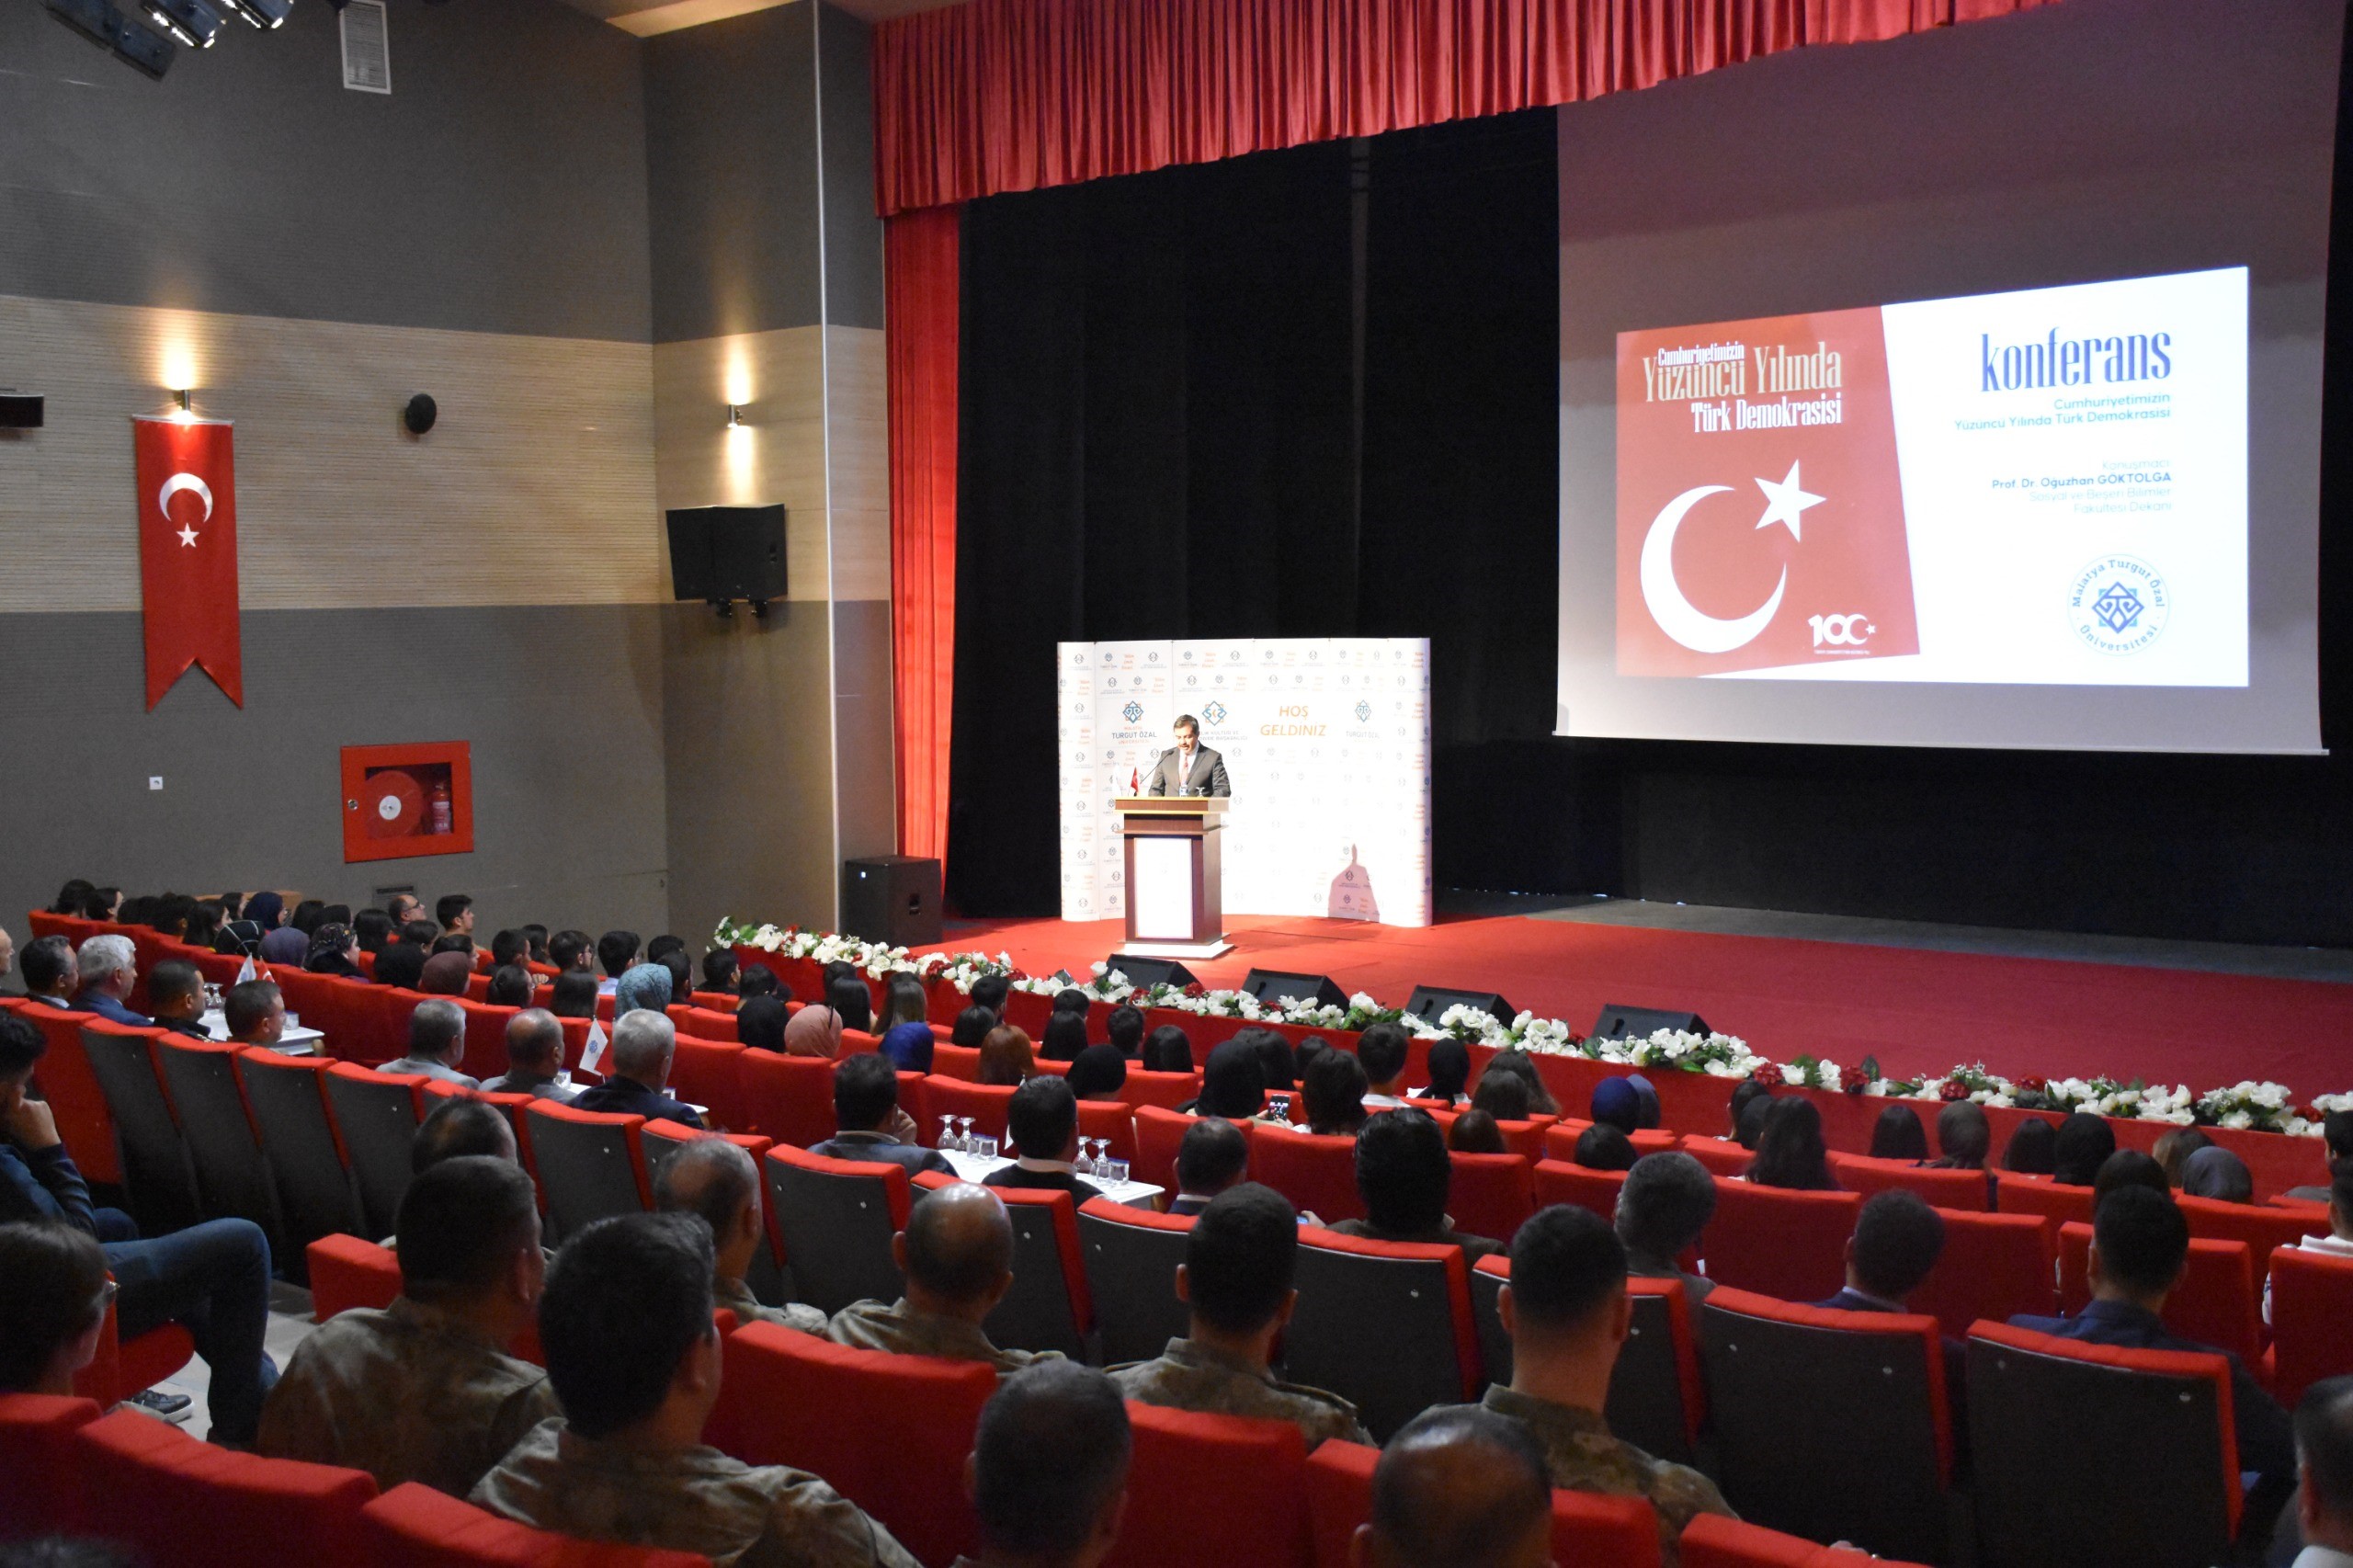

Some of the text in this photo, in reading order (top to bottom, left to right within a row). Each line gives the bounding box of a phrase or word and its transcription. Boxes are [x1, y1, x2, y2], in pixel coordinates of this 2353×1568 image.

[1657, 341, 1745, 367] Cumhuriyetimizin
[1754, 341, 1843, 393] Yılında
[1980, 326, 2171, 392] konferans
[1691, 392, 1842, 433] Türk Demokrasisi
[2053, 392, 2171, 410] Cumhuriyetimizin
[2086, 407, 2171, 423] Demokrasisi
[2097, 472, 2172, 485] GÖKTOLGA
[2072, 559, 2165, 608] Malatya Turgut Özal
[2079, 624, 2158, 652] Üniversitesi
[1279, 705, 1309, 721] HOŞ
[1260, 722, 1327, 736] GELDİNİZ
